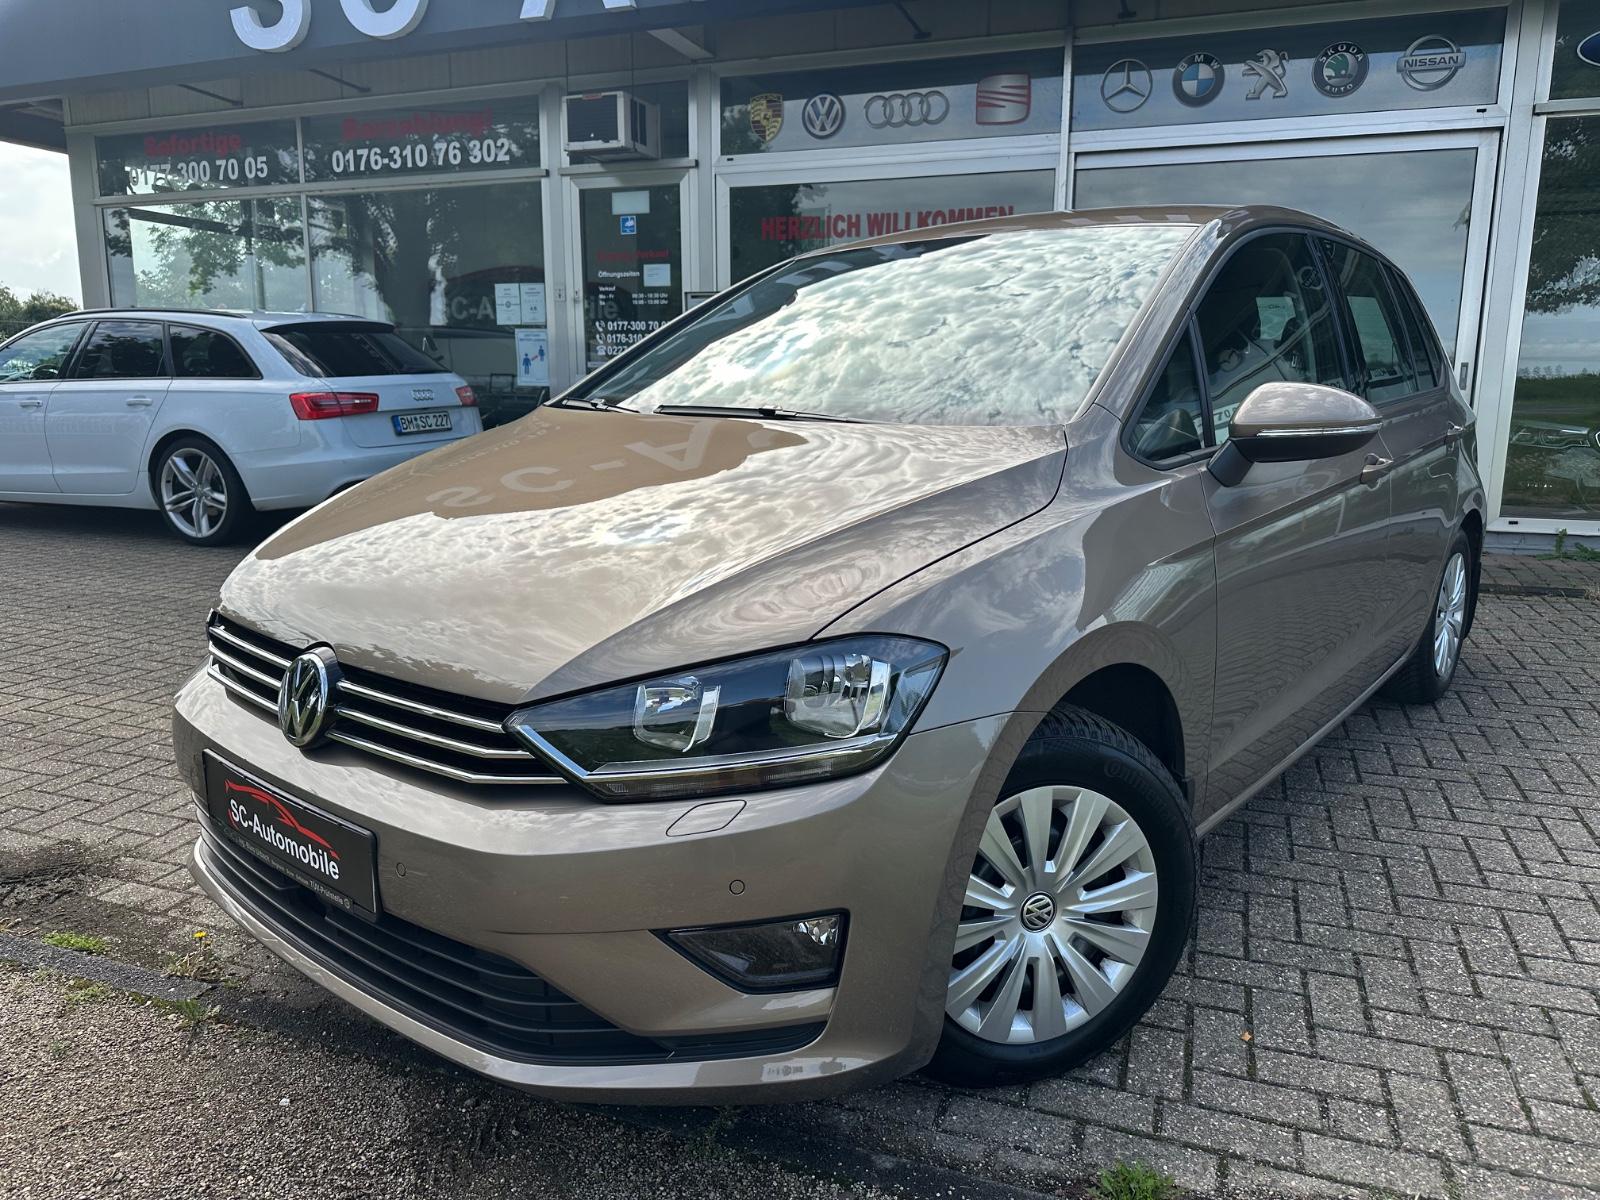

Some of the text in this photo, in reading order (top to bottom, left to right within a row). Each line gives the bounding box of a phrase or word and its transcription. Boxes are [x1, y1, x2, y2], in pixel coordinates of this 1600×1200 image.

[1179, 54, 1221, 72] BMW
[1403, 56, 1459, 68] NISSAN
[1325, 83, 1353, 93] AUTO
[332, 138, 510, 173] 0176-310 76 302
[216, 158, 239, 180] 70
[245, 156, 268, 179] 05
[761, 214, 861, 241] HERZLICH
[607, 321, 646, 331] 0177-300
[649, 321, 659, 331] 70
[607, 334, 642, 343] 0176-310
[400, 414, 449, 430] BM SC 227
[230, 798, 340, 880] SC-Automobile
